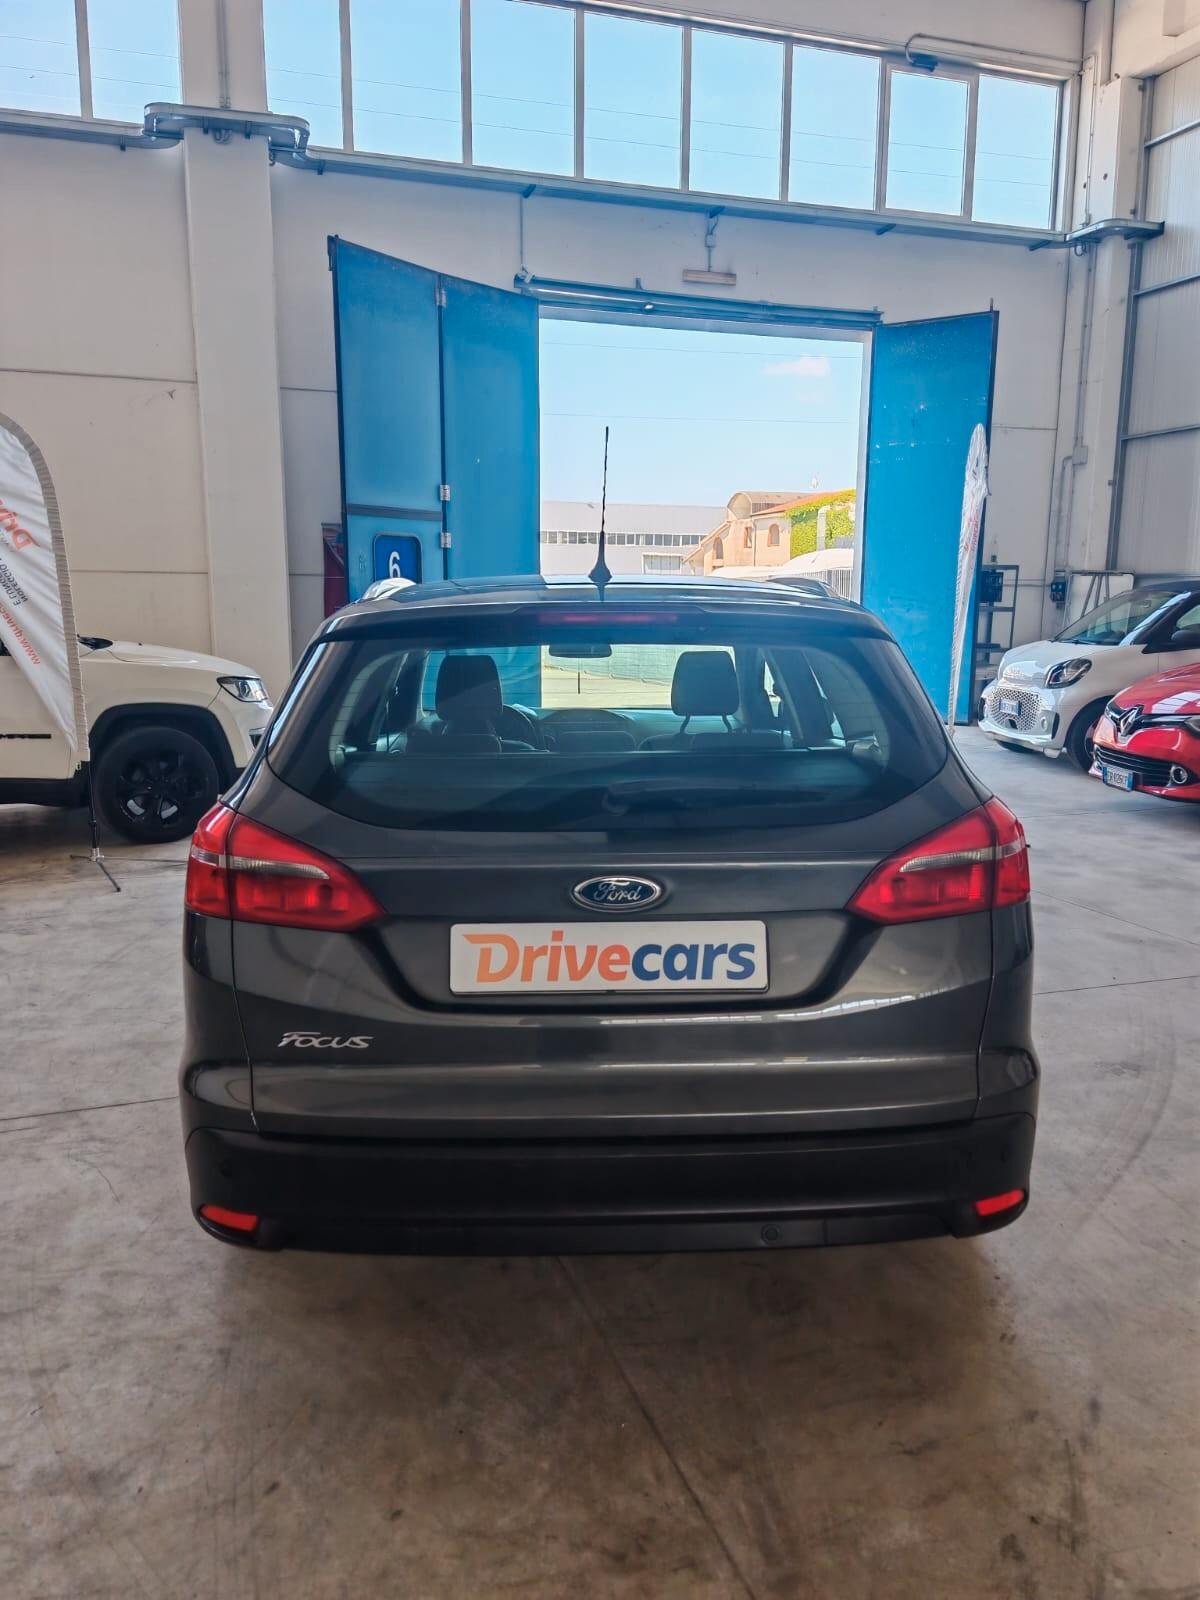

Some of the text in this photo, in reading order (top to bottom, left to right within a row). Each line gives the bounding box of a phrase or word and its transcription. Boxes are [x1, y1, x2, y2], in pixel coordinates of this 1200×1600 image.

[389, 551, 401, 579] 6
[593, 880, 643, 901] Ford
[461, 930, 756, 983] Drivecars
